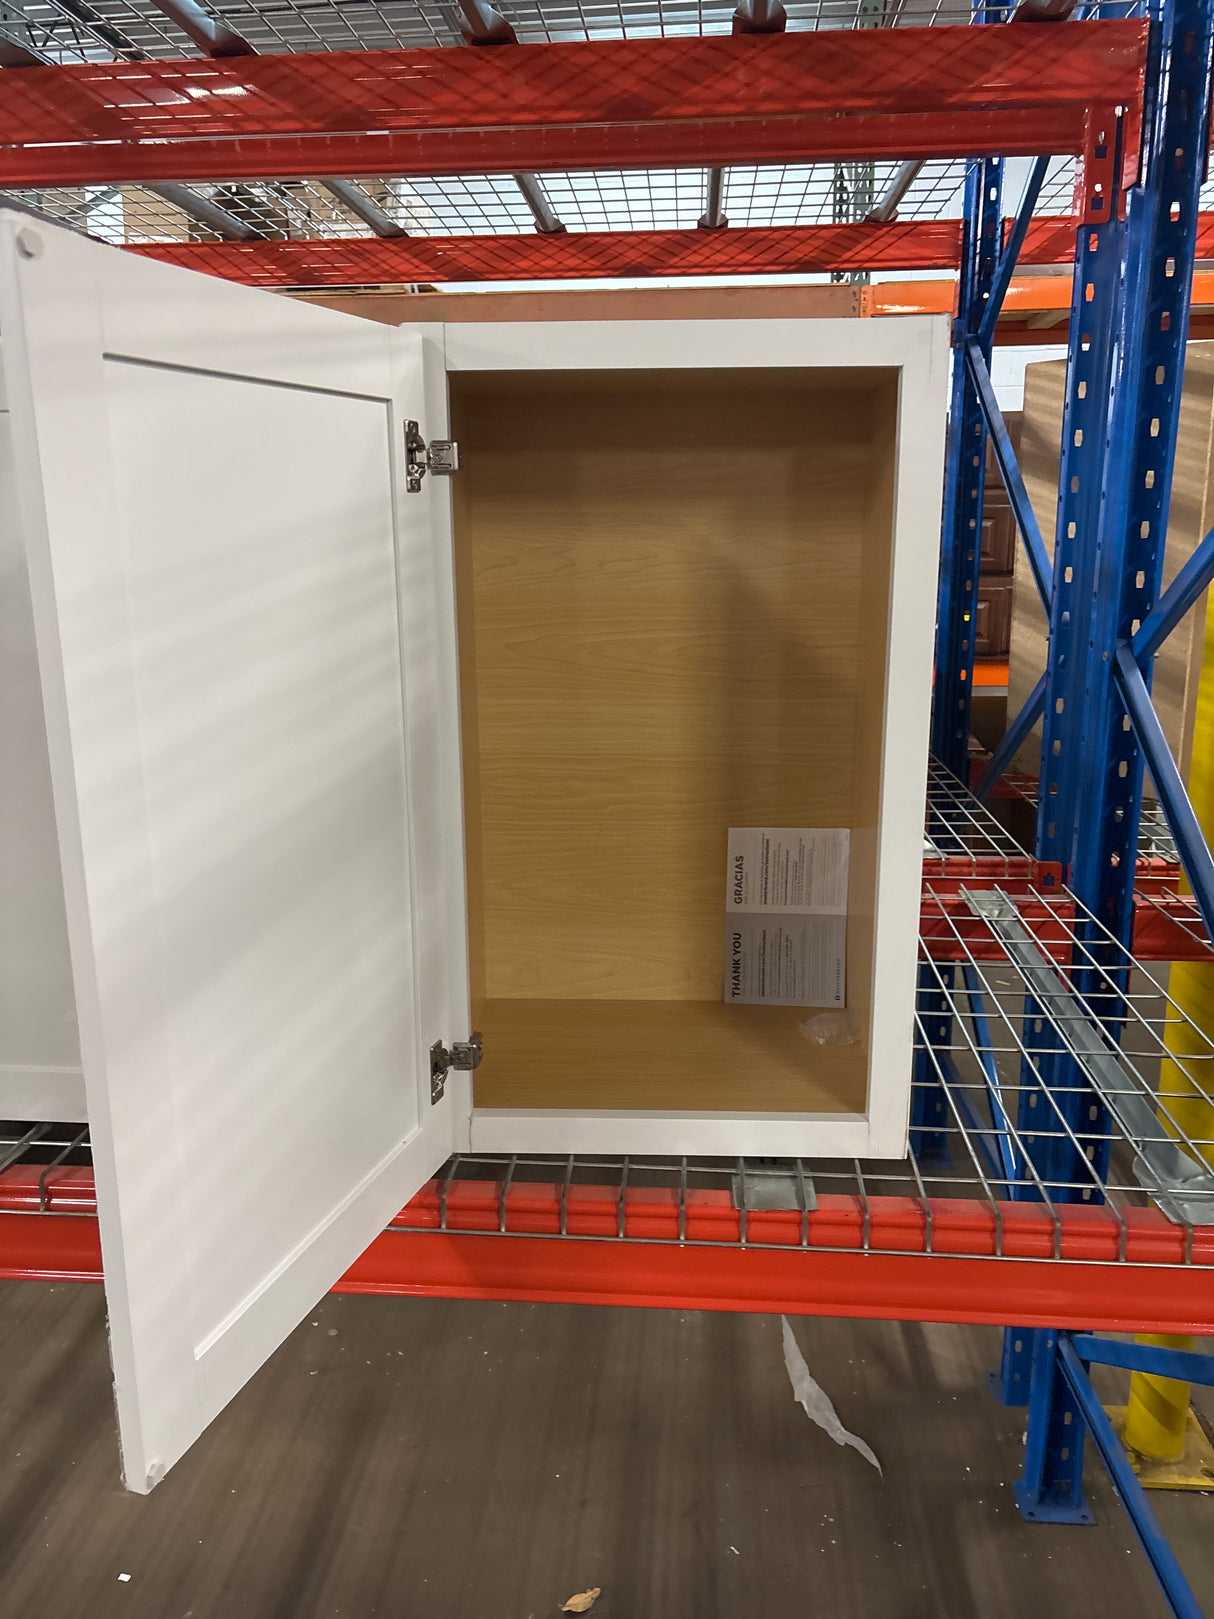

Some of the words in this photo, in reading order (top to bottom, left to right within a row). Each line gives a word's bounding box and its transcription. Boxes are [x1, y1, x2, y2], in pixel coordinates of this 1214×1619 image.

[733, 855, 744, 905] GRACIAS
[732, 932, 742, 956] YOU
[732, 959, 741, 998] THANK
